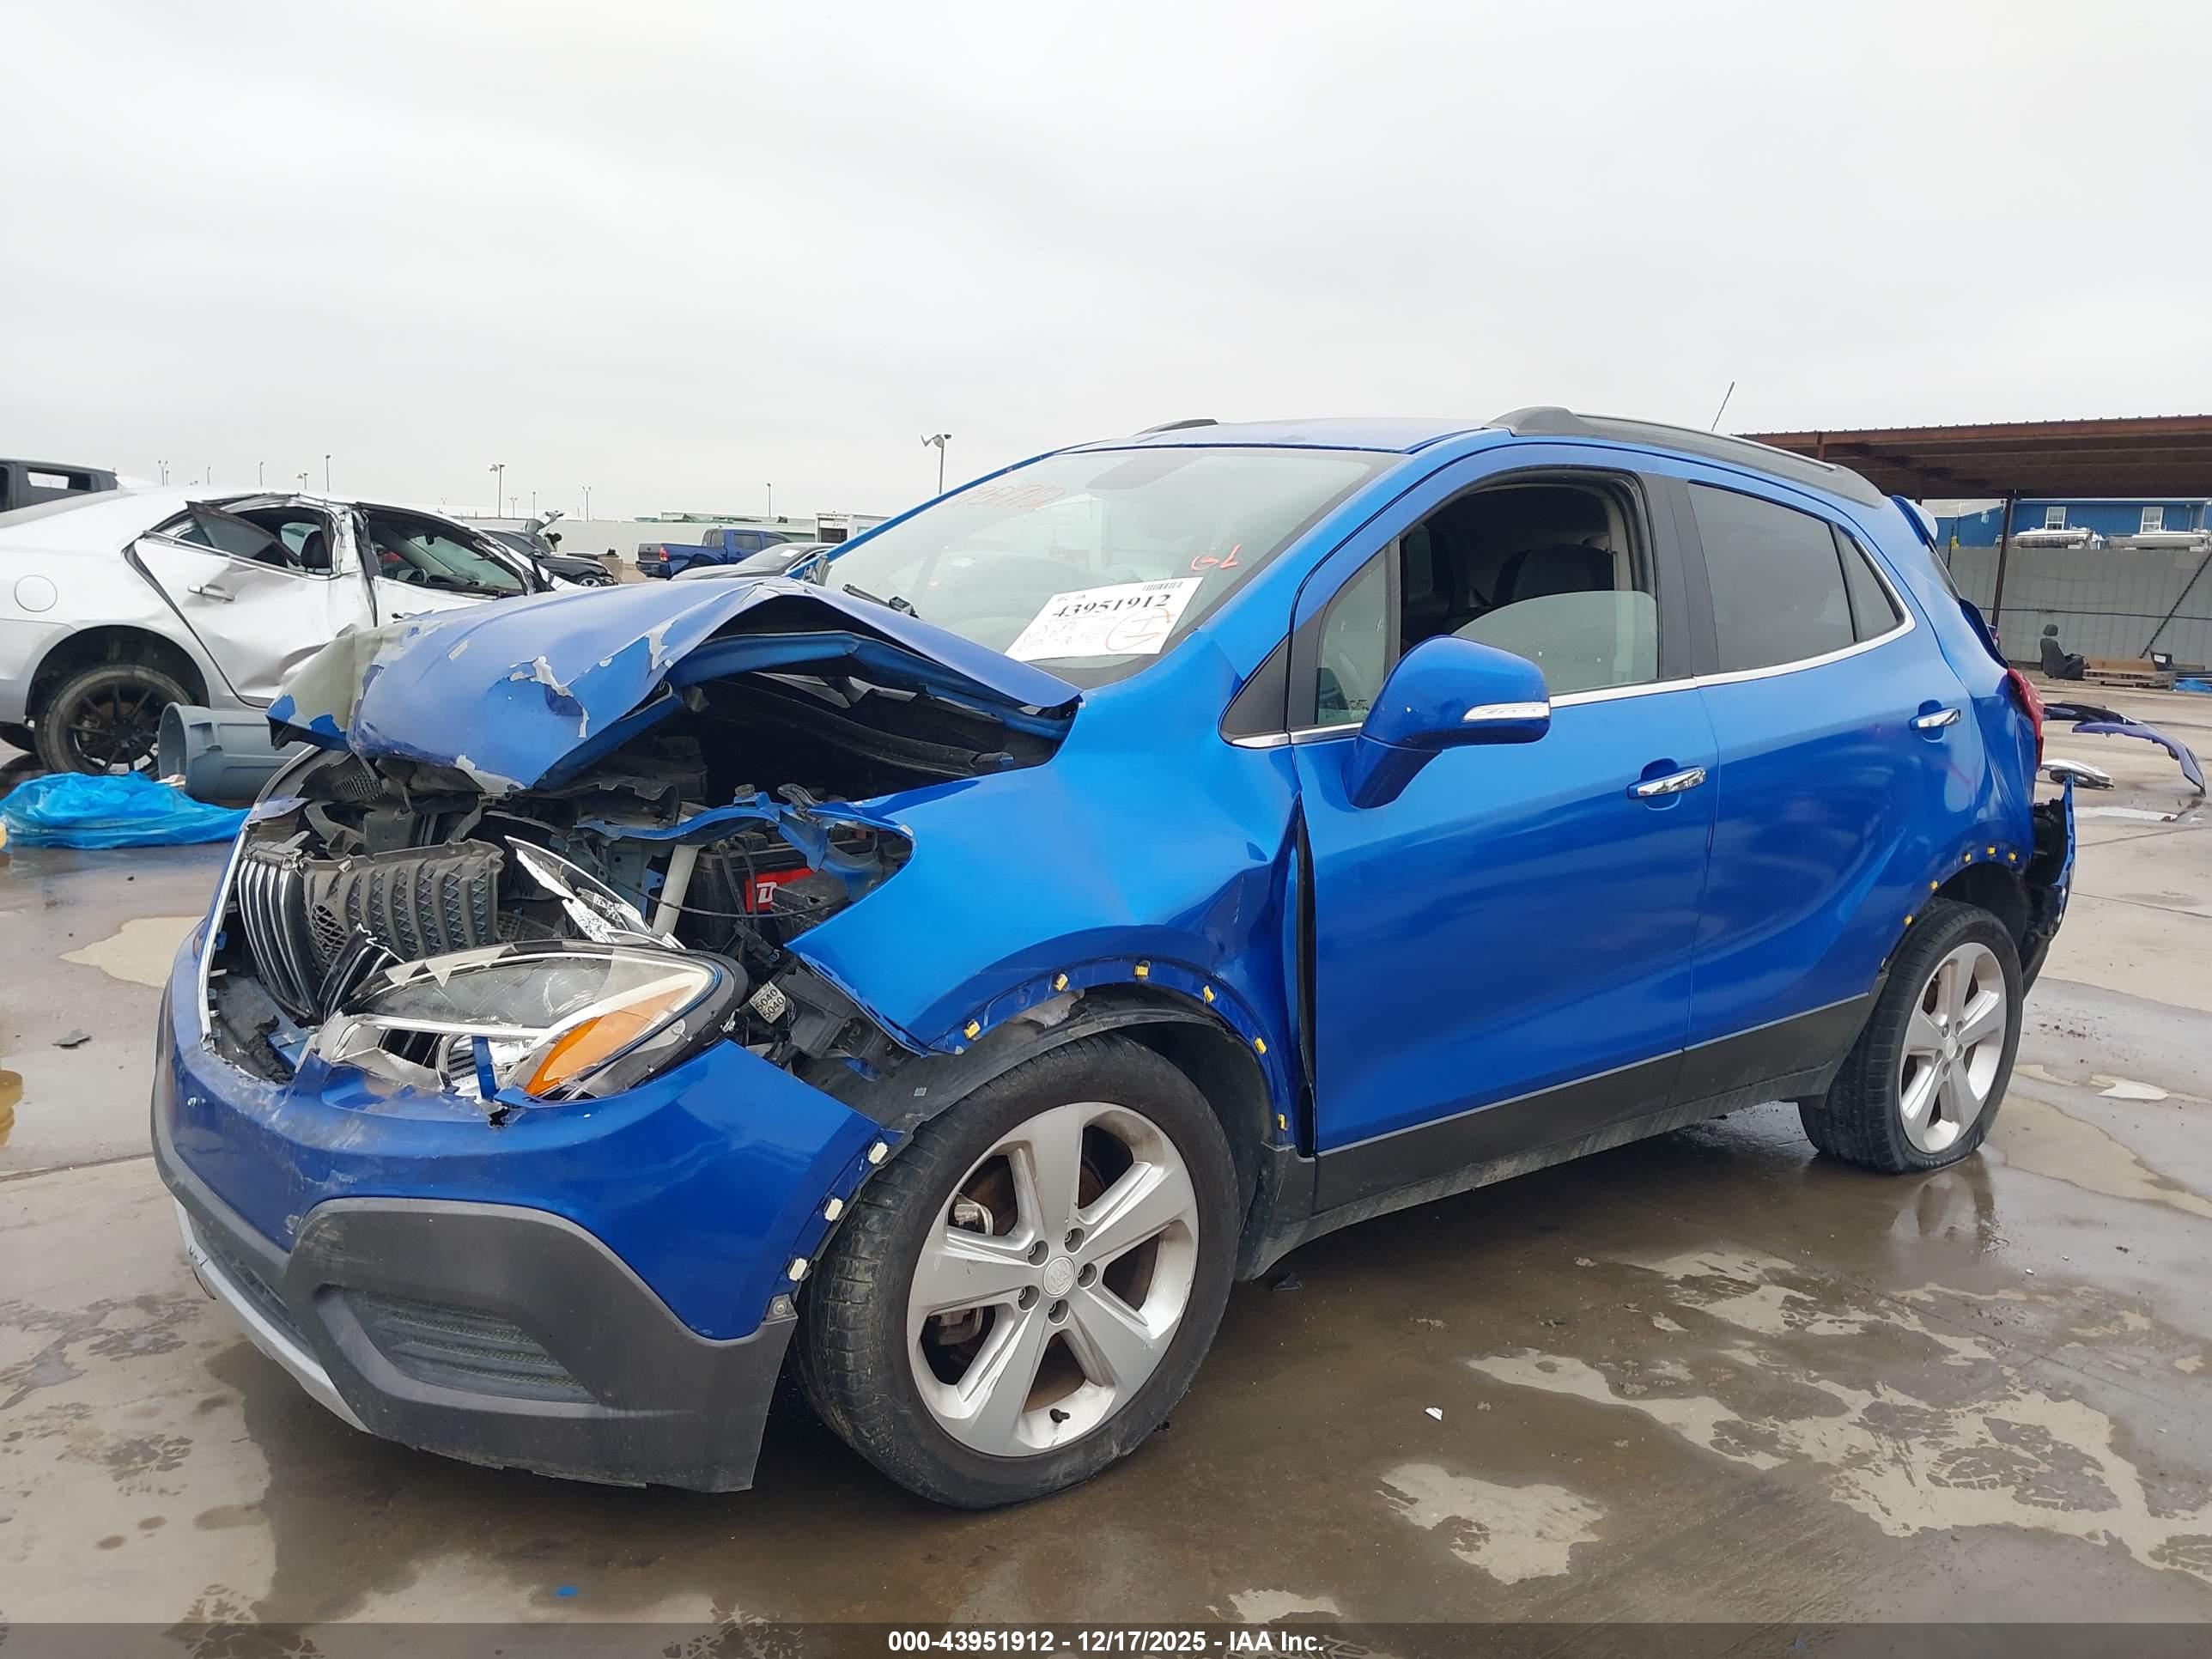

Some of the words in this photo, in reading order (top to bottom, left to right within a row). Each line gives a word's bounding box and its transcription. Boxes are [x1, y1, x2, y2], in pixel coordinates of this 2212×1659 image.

[1052, 594, 1171, 618] 43951912
[756, 988, 778, 1011] 5040
[763, 996, 785, 1018] 5040
